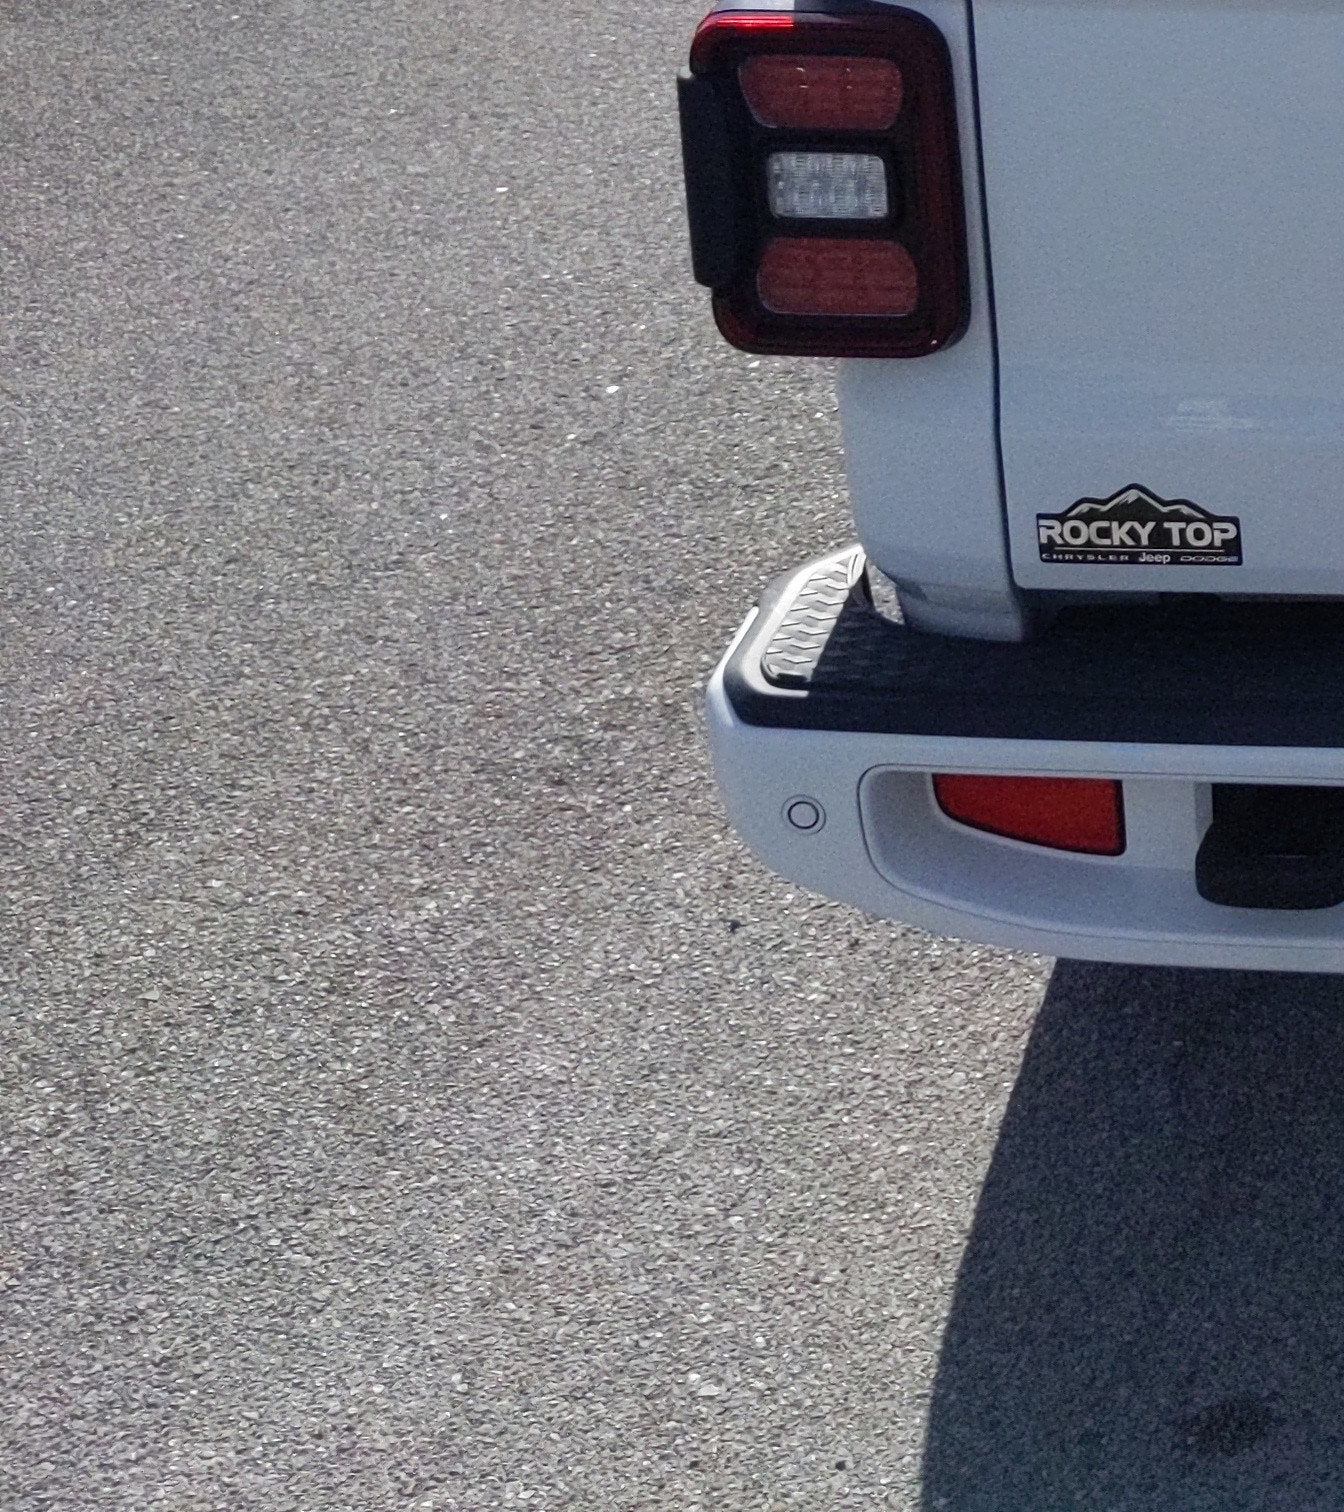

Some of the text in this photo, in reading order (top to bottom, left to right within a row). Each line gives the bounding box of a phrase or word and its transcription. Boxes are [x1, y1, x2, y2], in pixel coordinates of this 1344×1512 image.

[1037, 518, 1238, 547] ROCKY TOP
[1041, 552, 1239, 565] CHRYSLER Jeep DODGE
